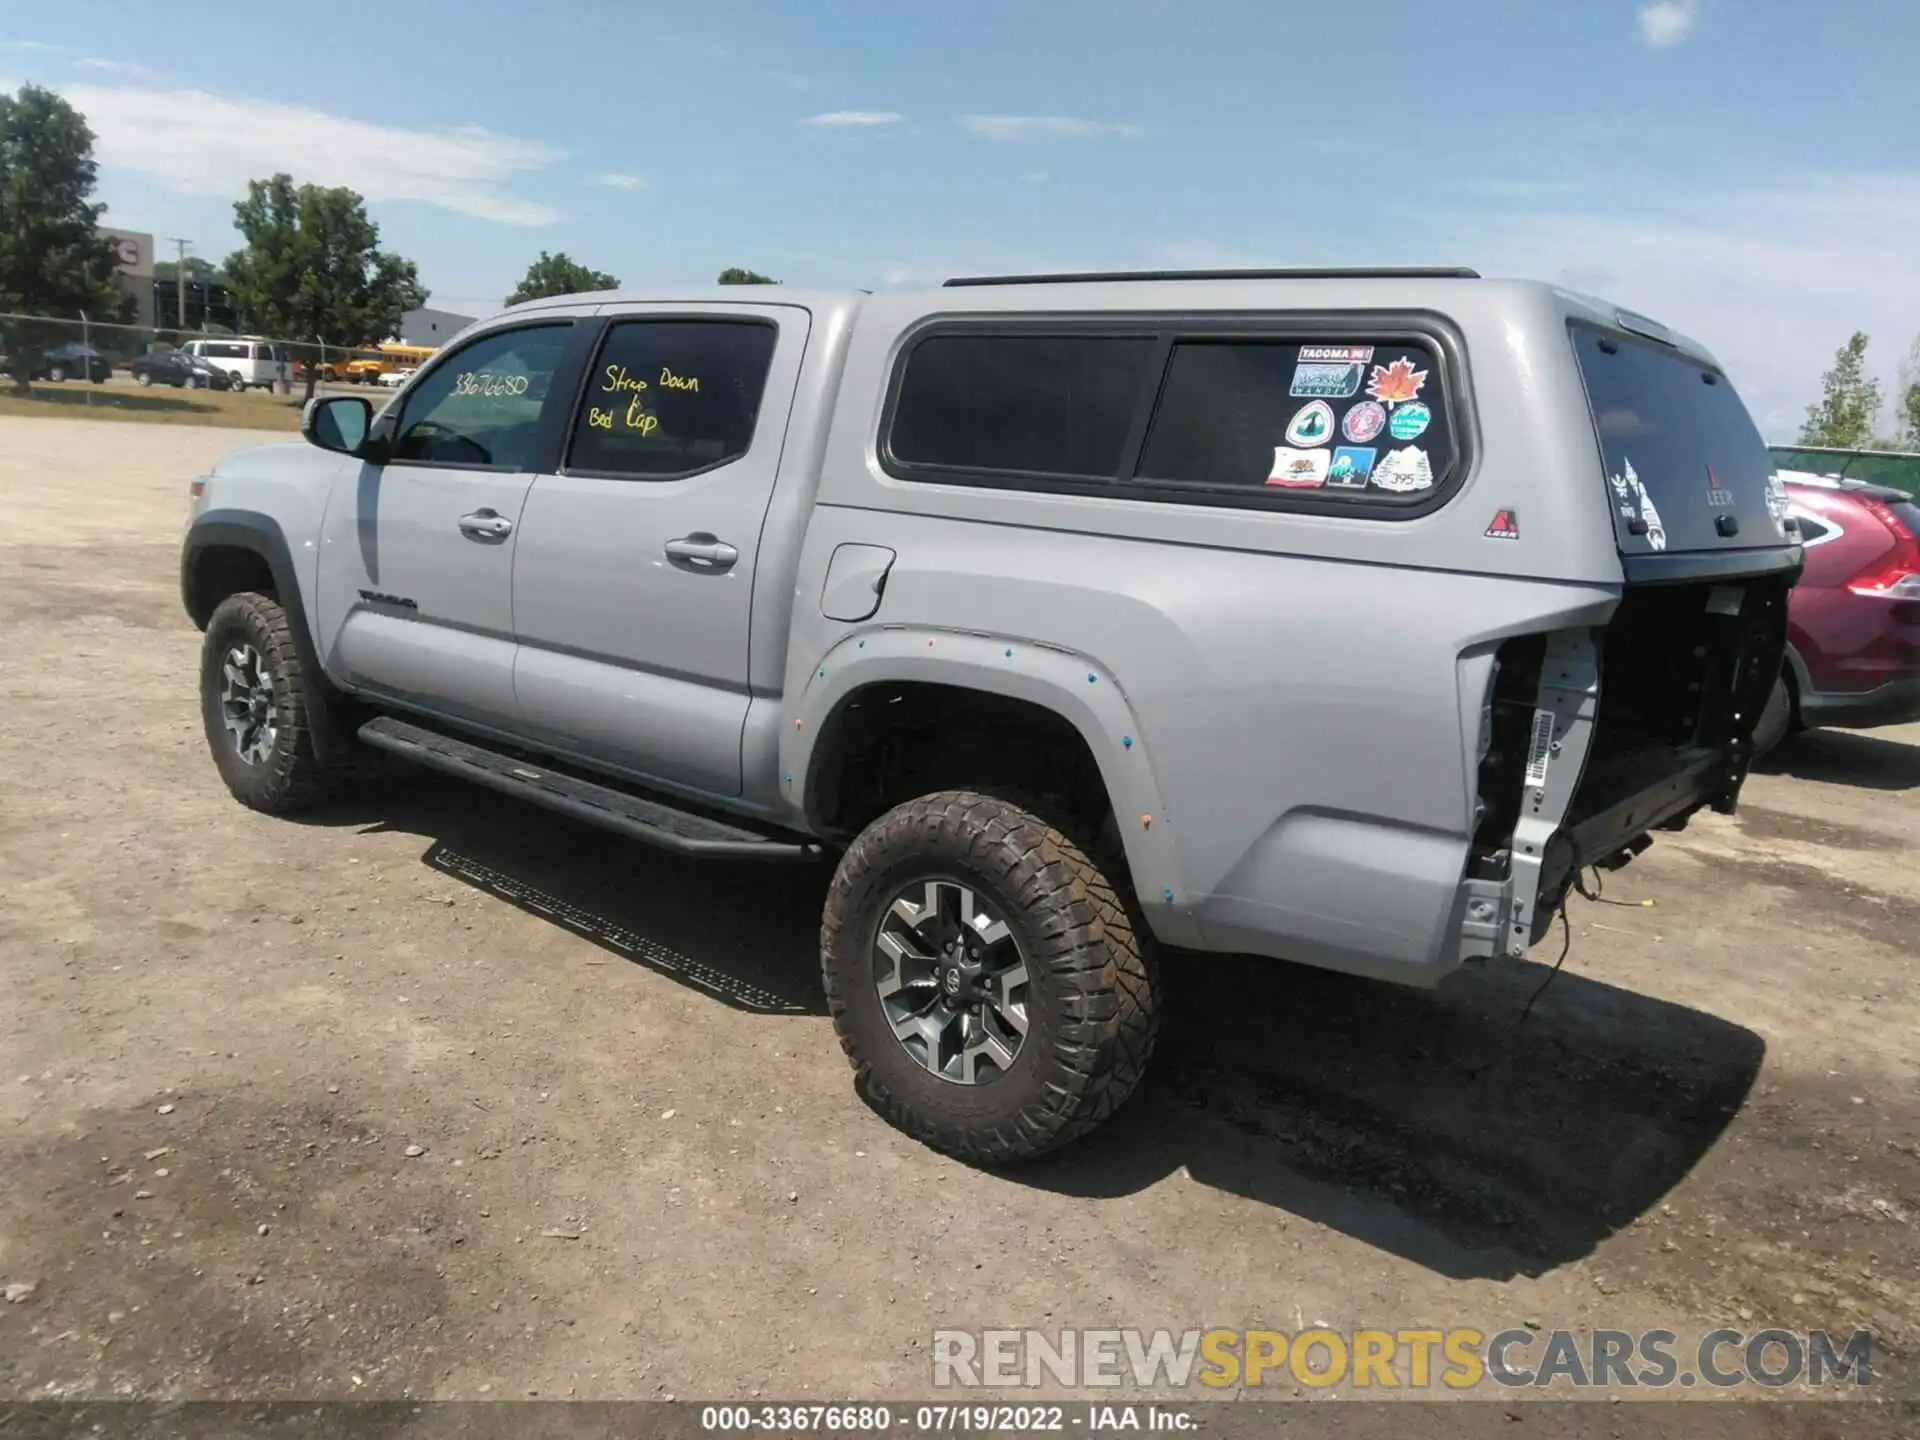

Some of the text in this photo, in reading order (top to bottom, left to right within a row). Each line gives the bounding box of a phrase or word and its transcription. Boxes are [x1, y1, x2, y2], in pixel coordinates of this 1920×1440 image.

[1303, 348, 1349, 359] TACOMA
[602, 365, 699, 392] Strap Down
[589, 397, 658, 437] Bed Cap
[1390, 472, 1416, 485] 395
[1705, 489, 1735, 507] LEER
